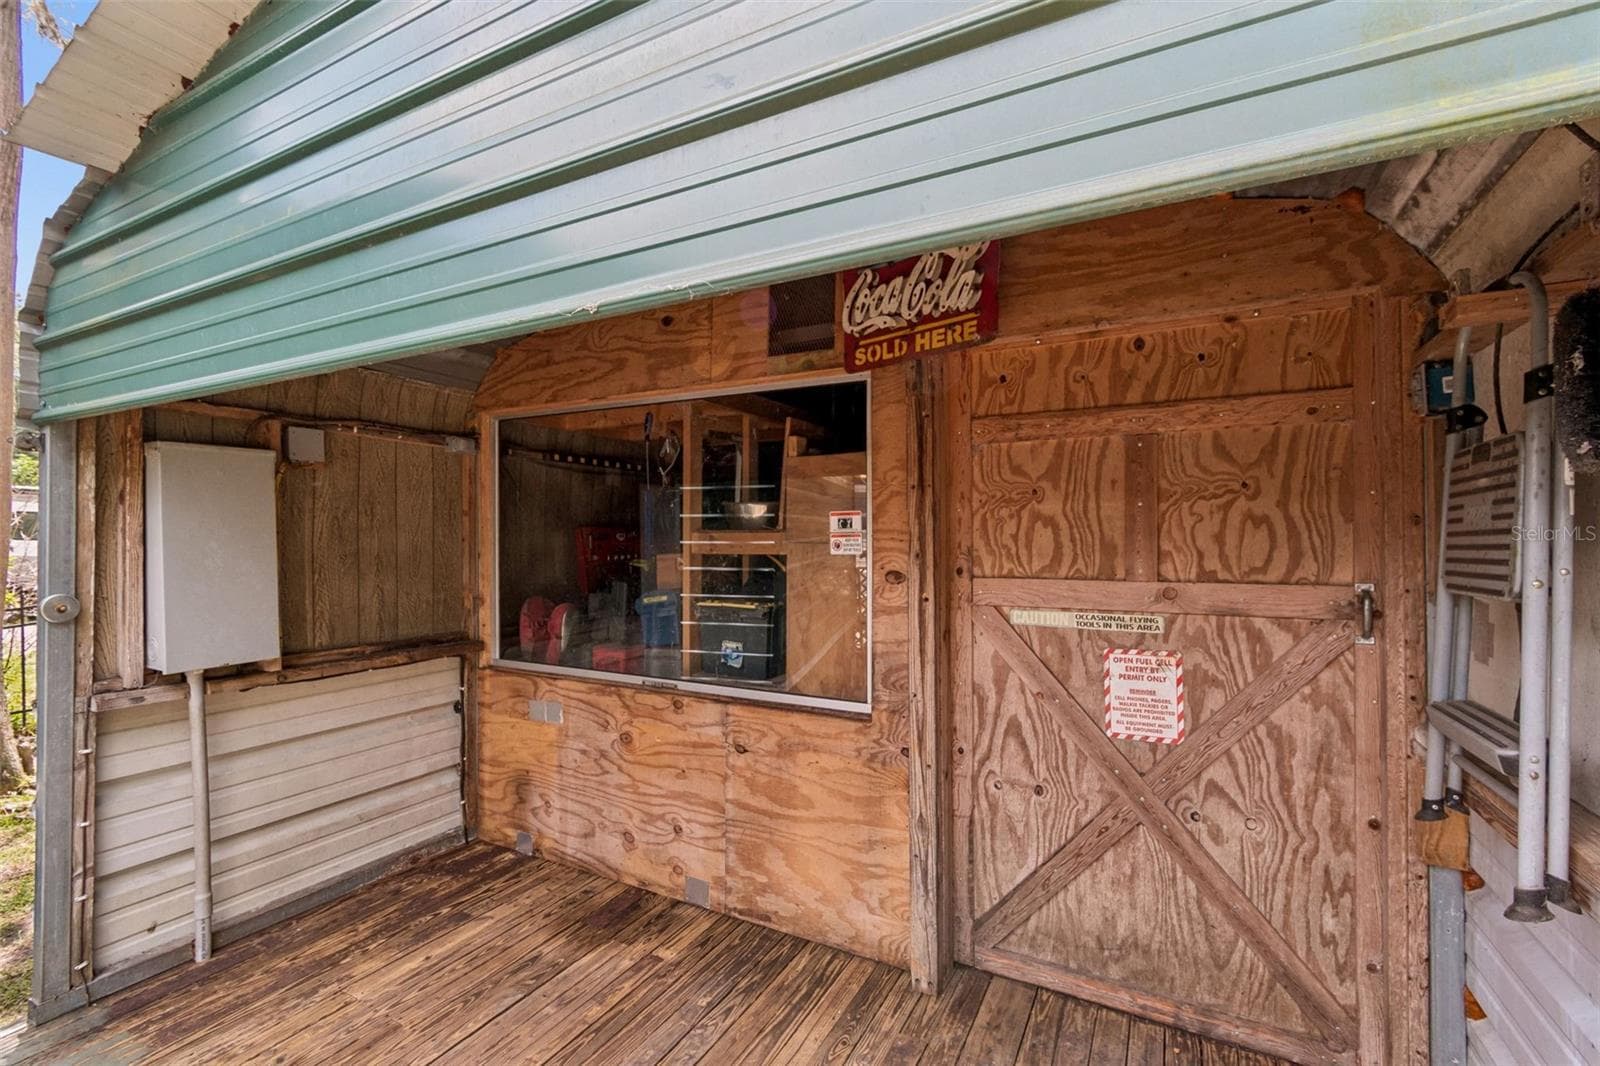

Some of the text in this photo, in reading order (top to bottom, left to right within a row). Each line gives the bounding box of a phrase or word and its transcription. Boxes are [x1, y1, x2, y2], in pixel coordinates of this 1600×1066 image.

[854, 320, 978, 366] SOLD HERE
[1012, 610, 1069, 625] CAUTION
[1075, 613, 1159, 624] OCCASIONAL FLYING
[1076, 620, 1101, 628] TOOLS
[1137, 624, 1160, 632] AREA
[1113, 656, 1134, 664] OPEN
[1125, 665, 1149, 673] ENTRY
